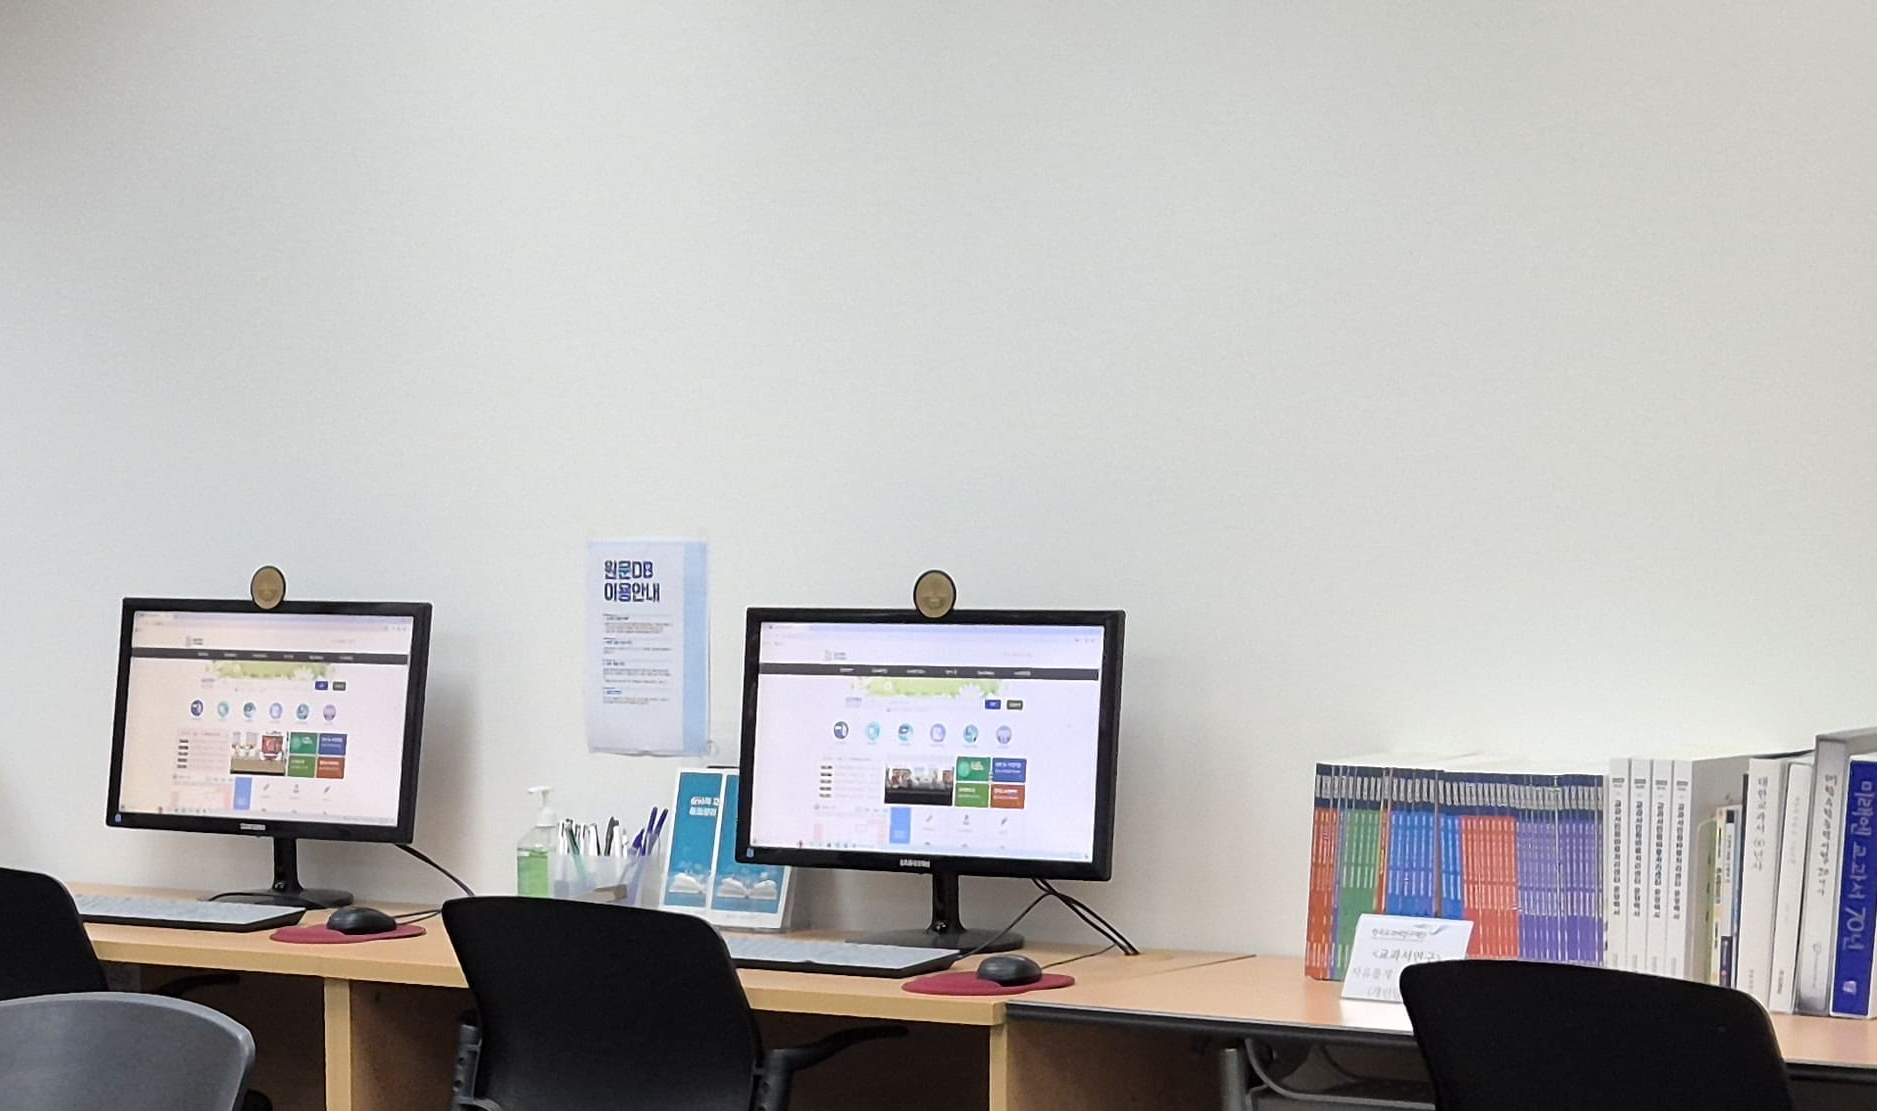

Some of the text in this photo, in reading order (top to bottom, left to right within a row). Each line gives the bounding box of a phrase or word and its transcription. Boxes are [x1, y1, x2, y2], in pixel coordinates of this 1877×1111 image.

[604, 560, 654, 580] 원문DB
[604, 582, 660, 602] 이용안내
[1843, 780, 1876, 950] 미래엔 교과서 70년
